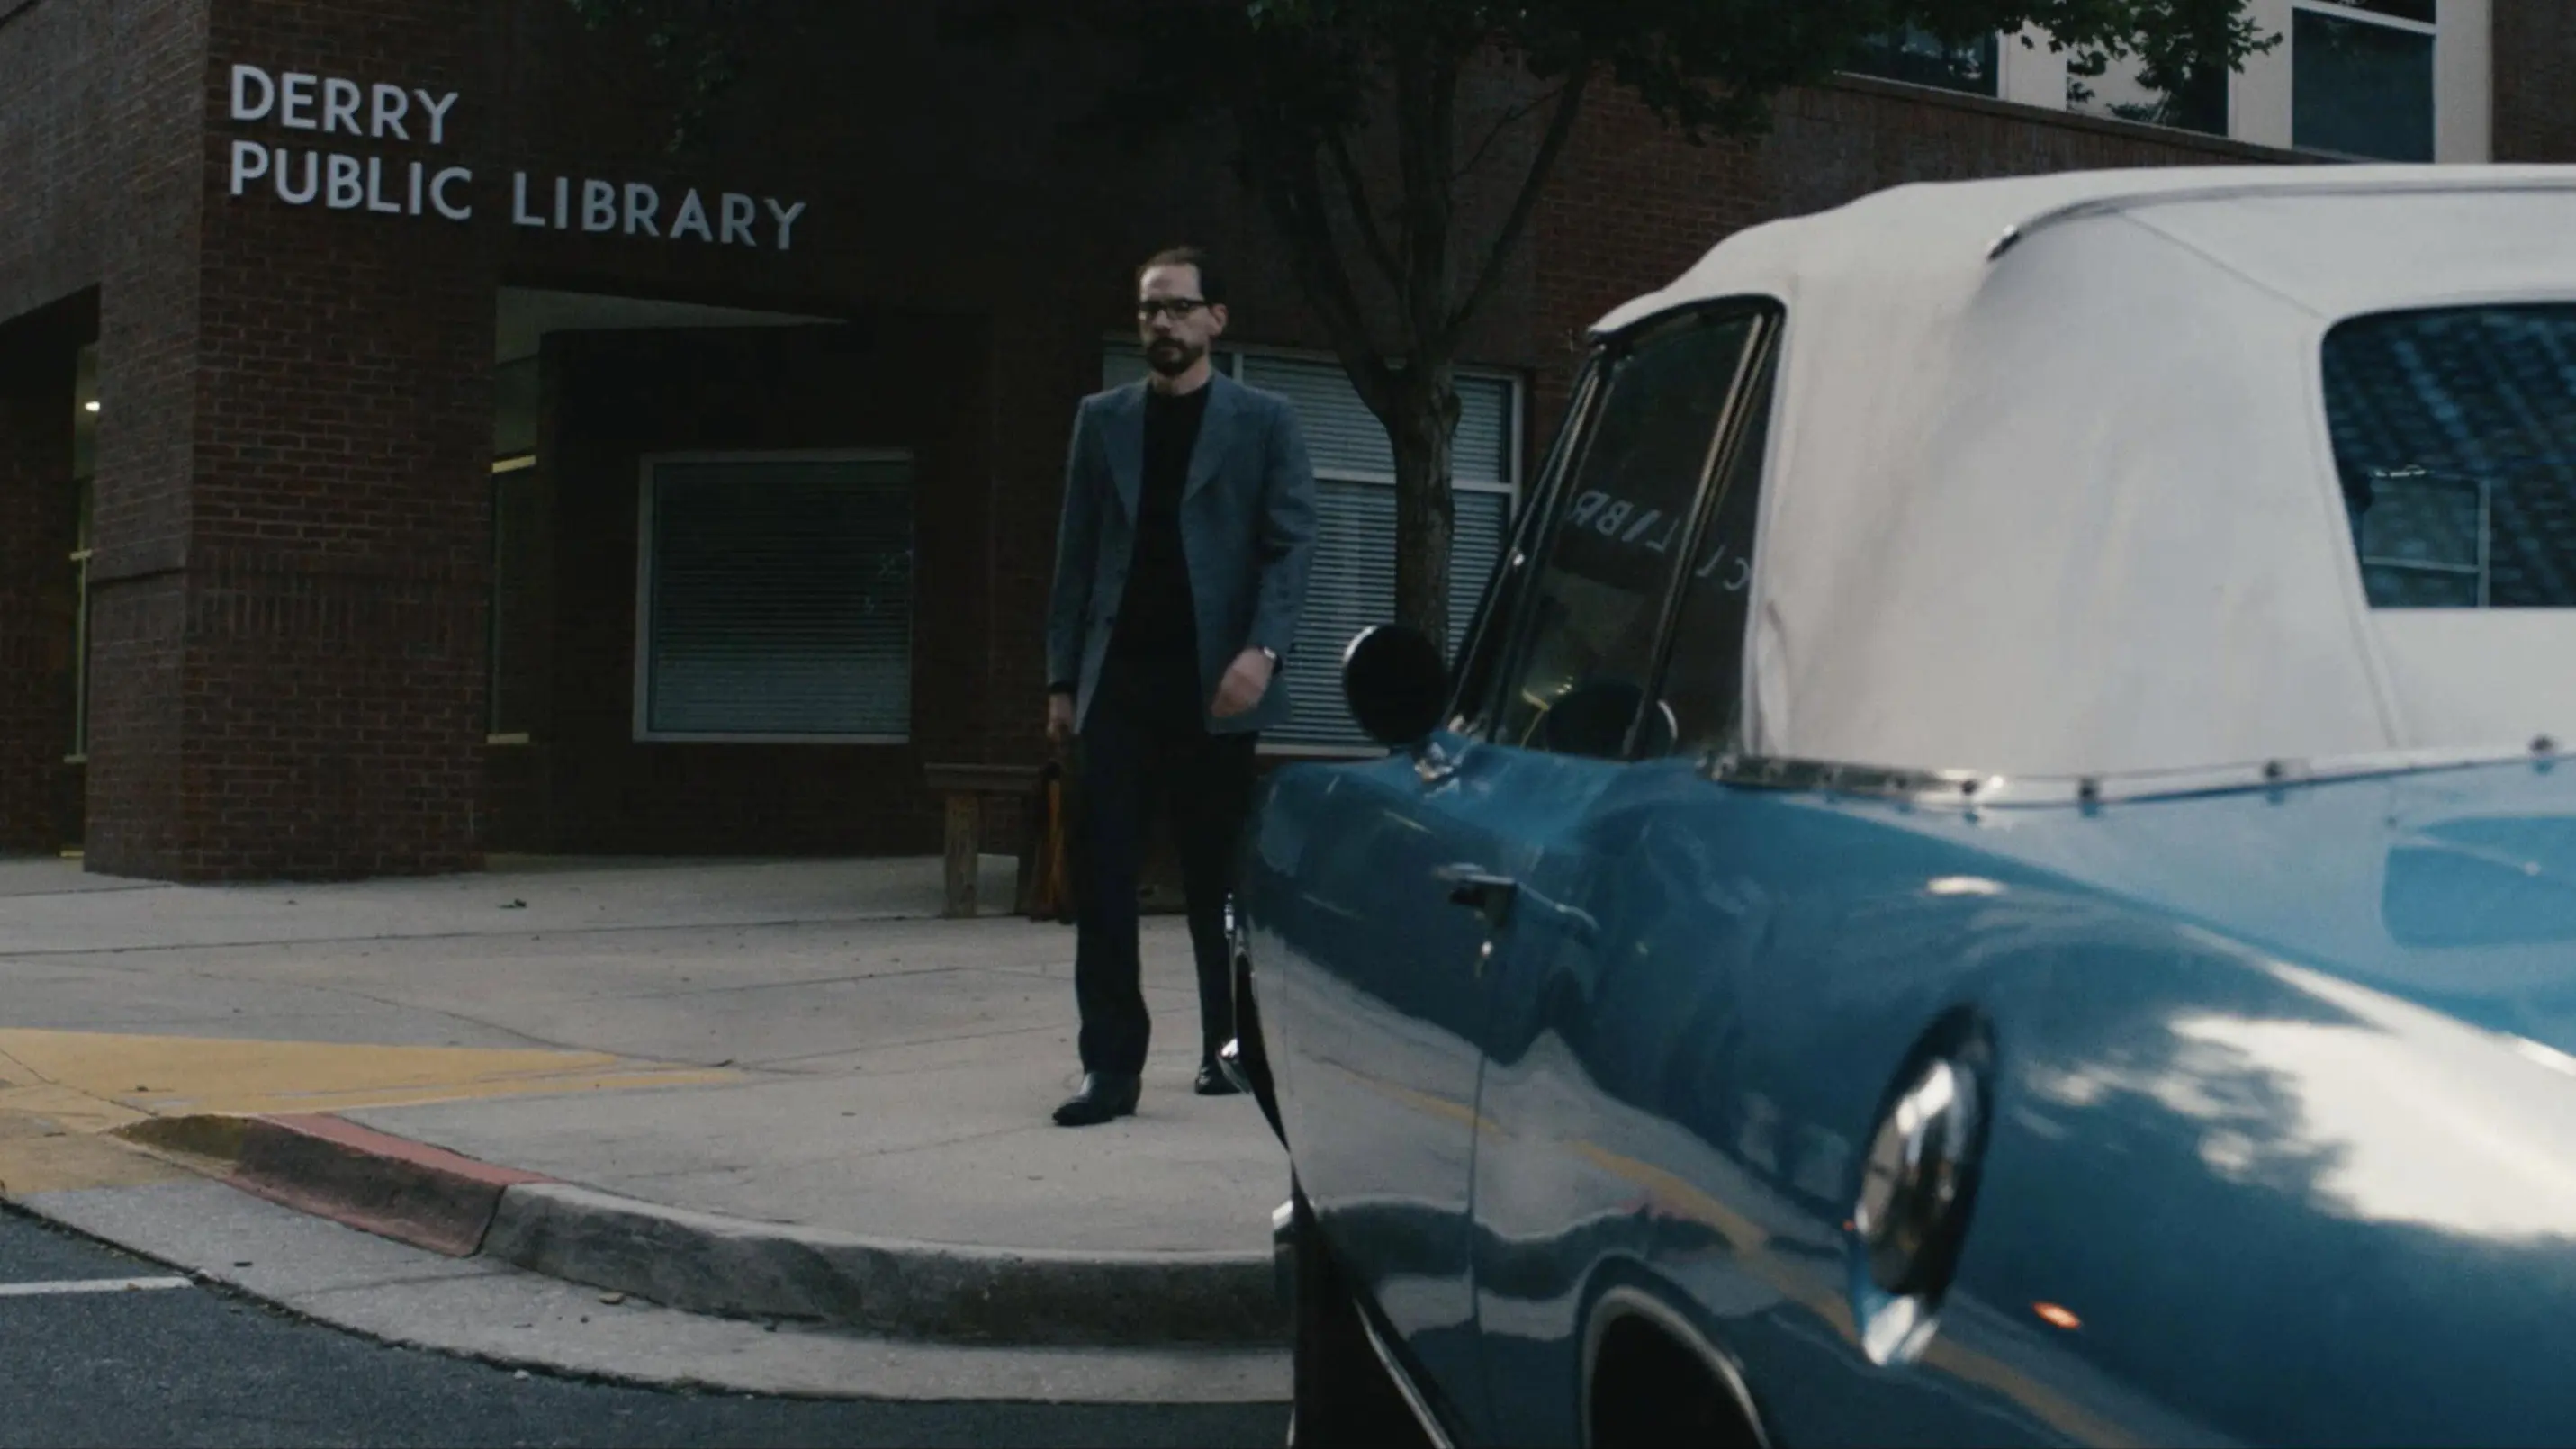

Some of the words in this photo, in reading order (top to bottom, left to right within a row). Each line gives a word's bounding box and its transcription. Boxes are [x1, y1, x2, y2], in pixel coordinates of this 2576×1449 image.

[230, 64, 459, 144] DERRY
[230, 140, 473, 220] PUBLIC
[512, 171, 806, 250] LIBRARY
